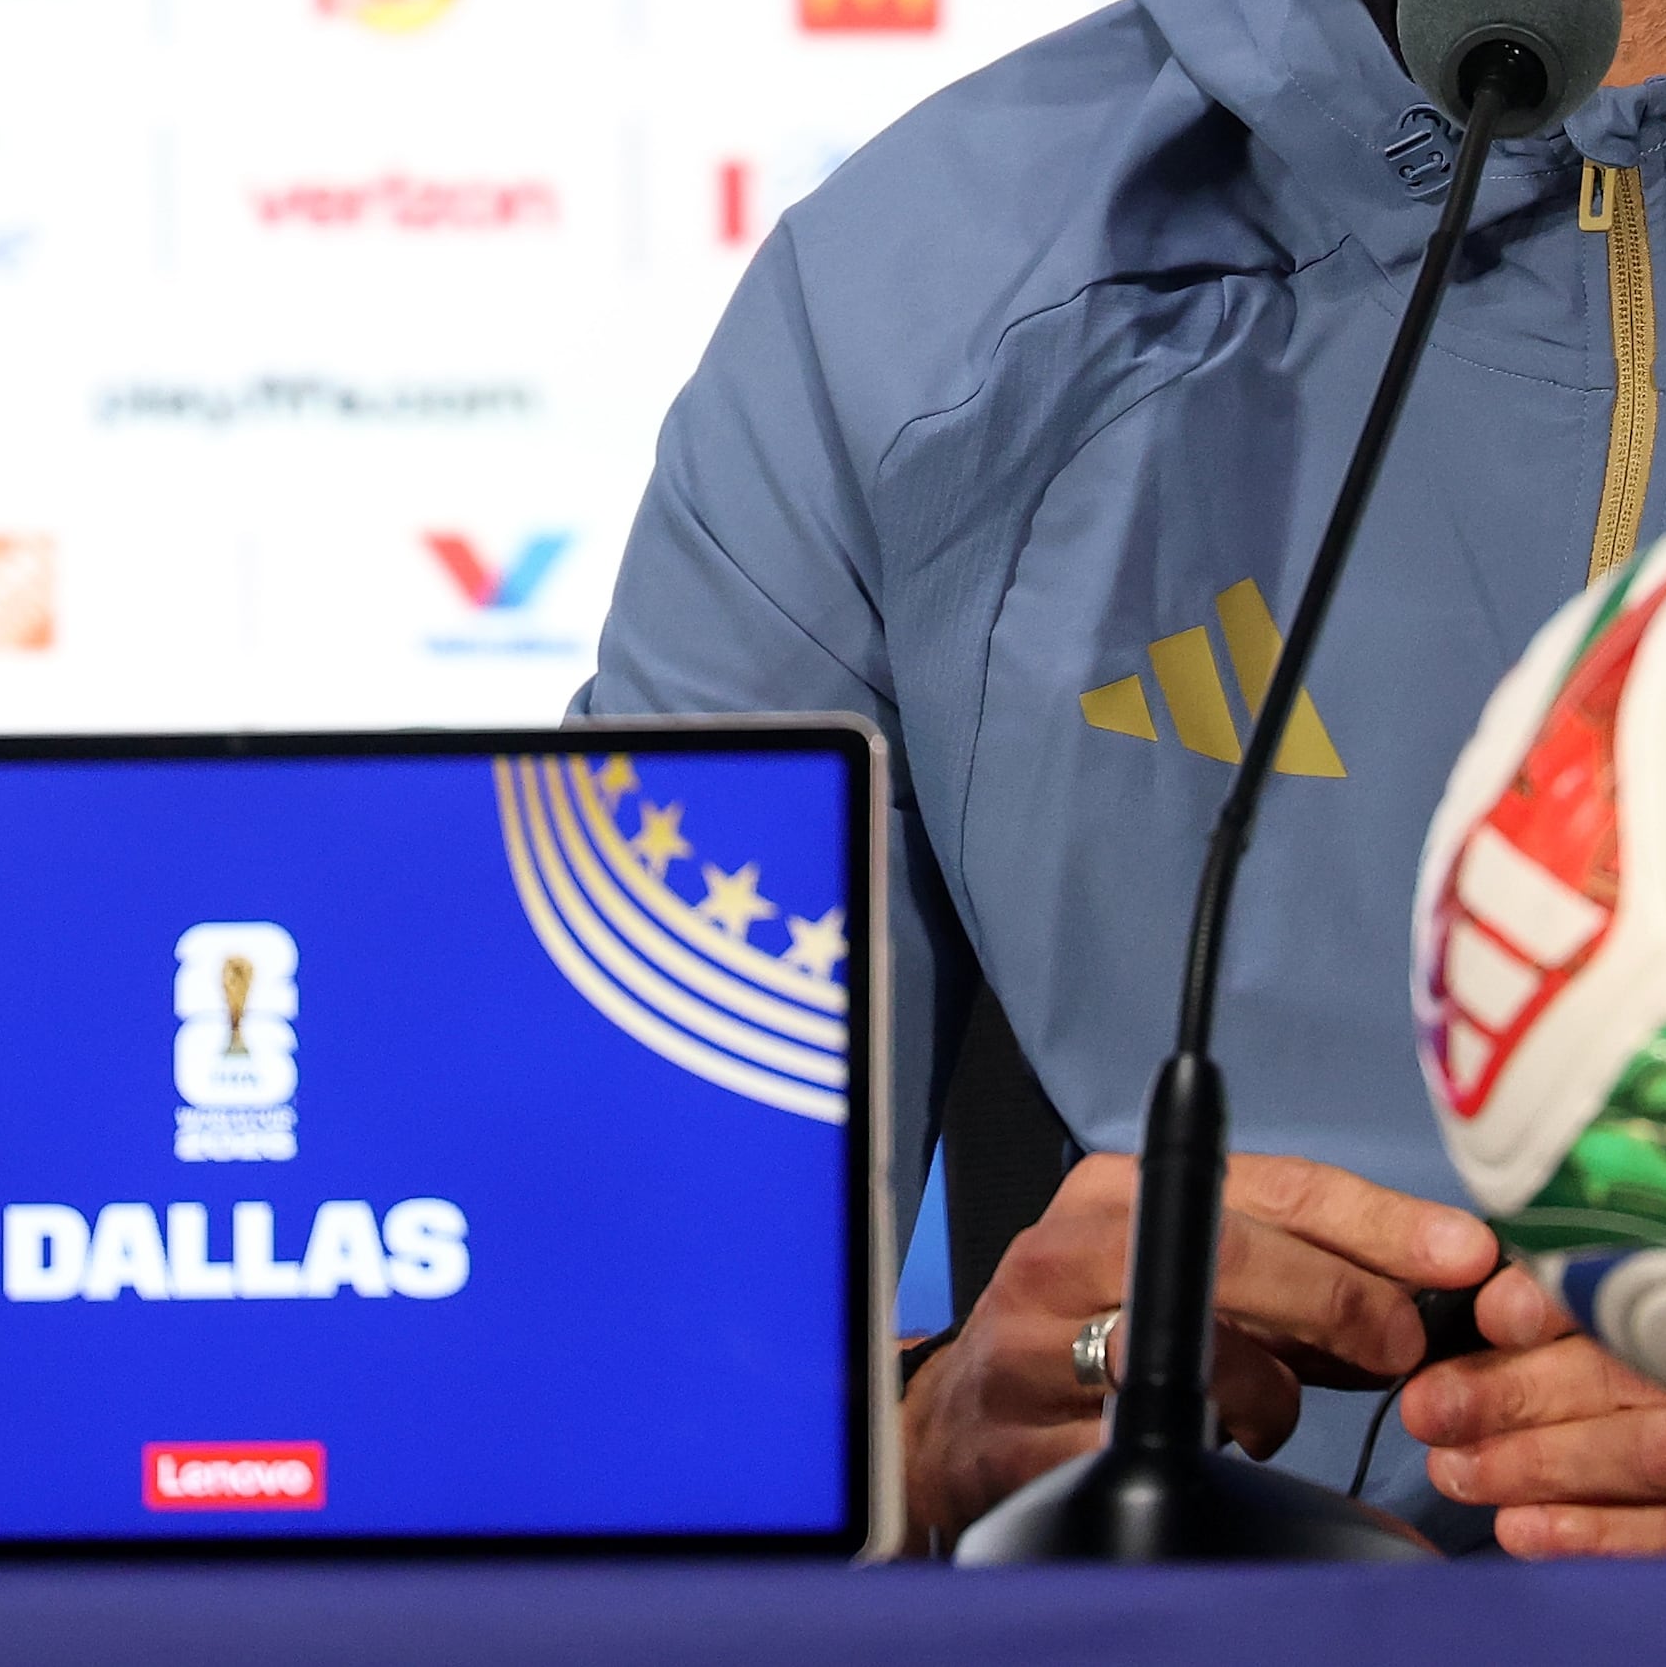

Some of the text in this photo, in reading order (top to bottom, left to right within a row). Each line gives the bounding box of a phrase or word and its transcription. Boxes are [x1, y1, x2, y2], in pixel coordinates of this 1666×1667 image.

[252, 172, 558, 234] verizon
[3, 1198, 470, 1302] DALLAS
[156, 1452, 312, 1498] Lenovo
